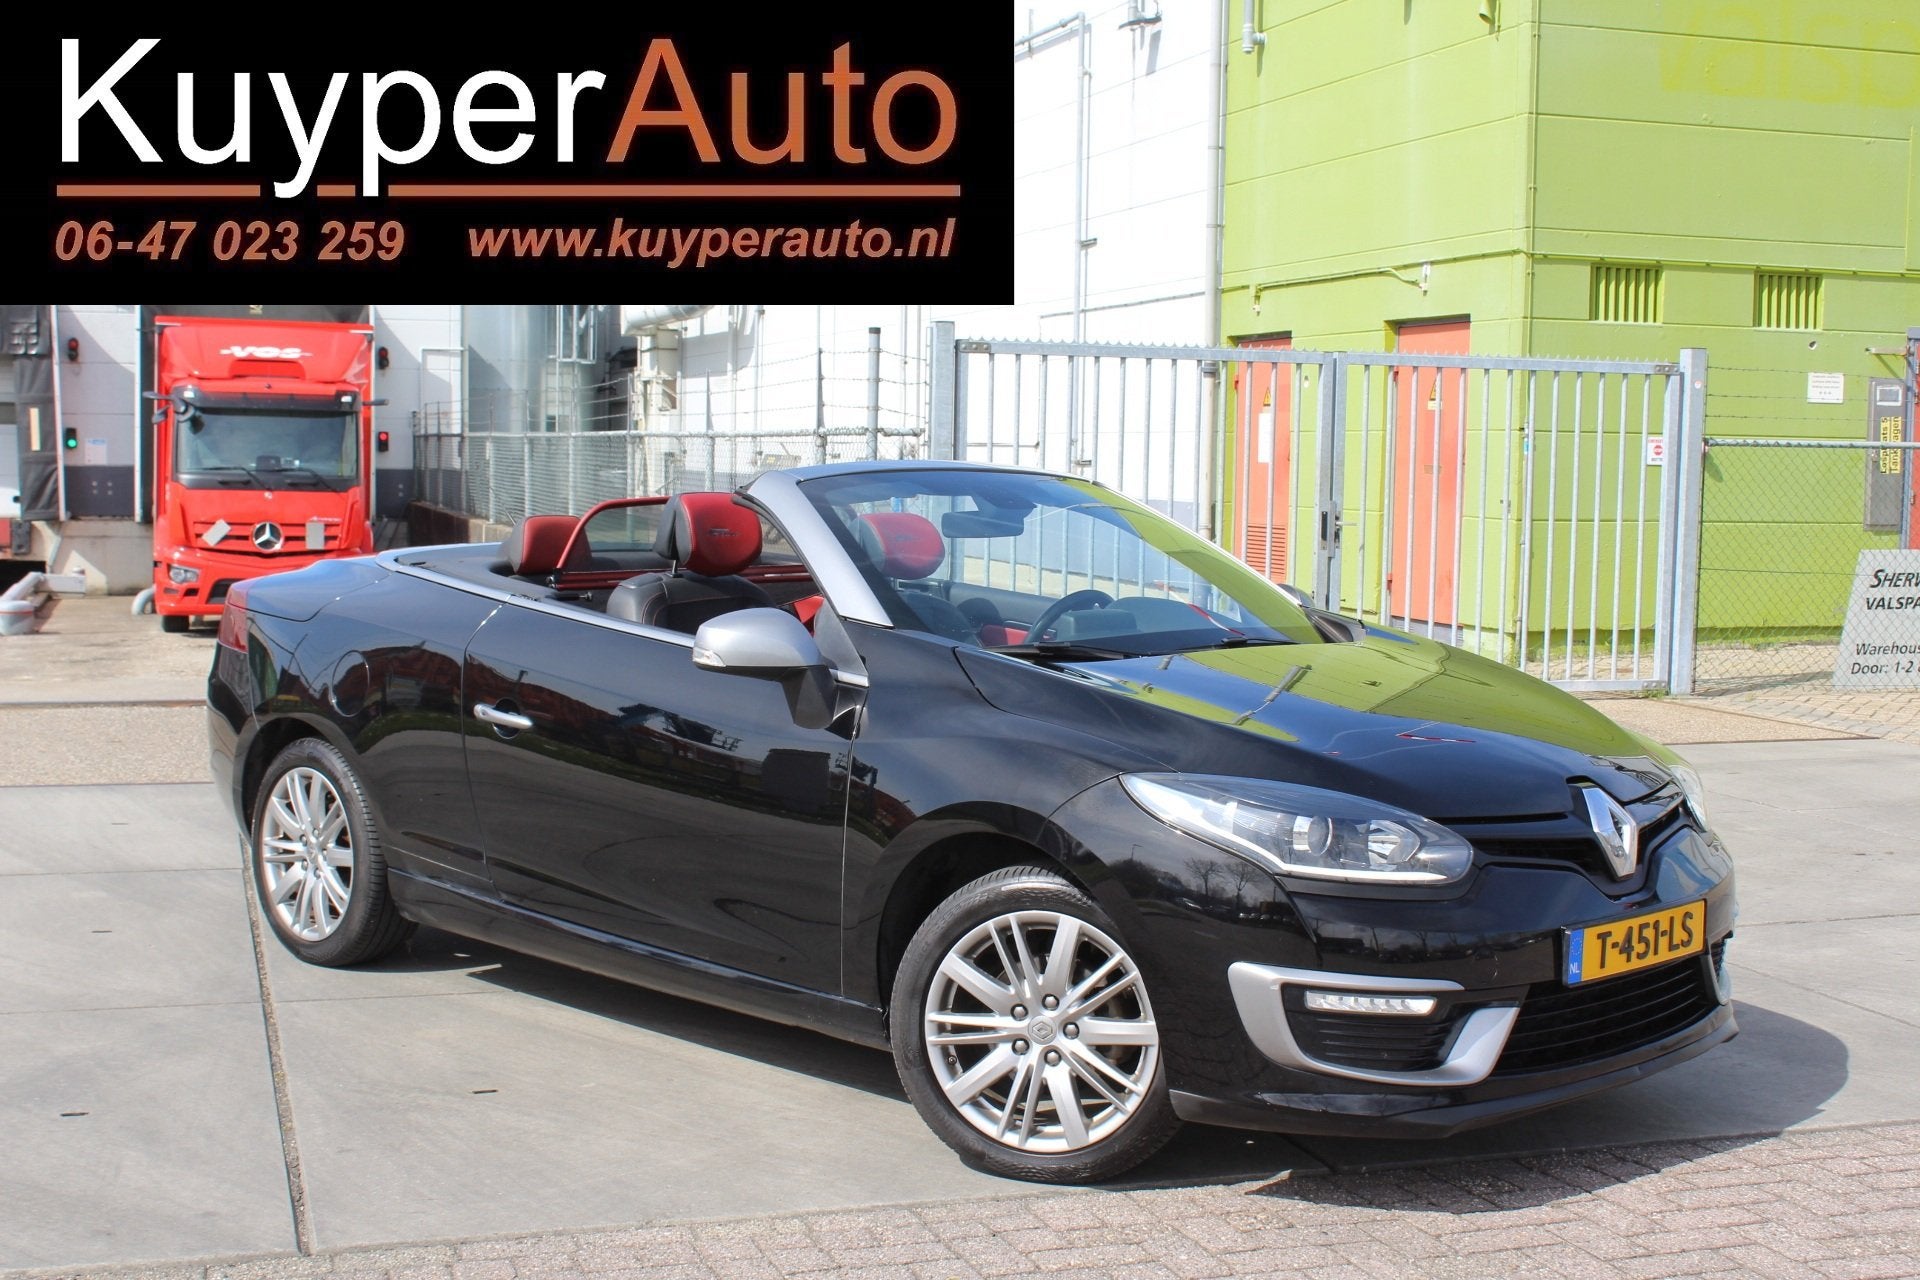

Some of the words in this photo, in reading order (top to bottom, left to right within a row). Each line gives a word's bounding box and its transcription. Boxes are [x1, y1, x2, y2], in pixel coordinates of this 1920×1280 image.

[1890, 416, 1900, 473] Tankagen
[1851, 661, 1889, 675] Door:
[1894, 660, 1915, 674] 1-2
[1597, 911, 1694, 970] T-451-LS
[1569, 962, 1581, 975] NL
